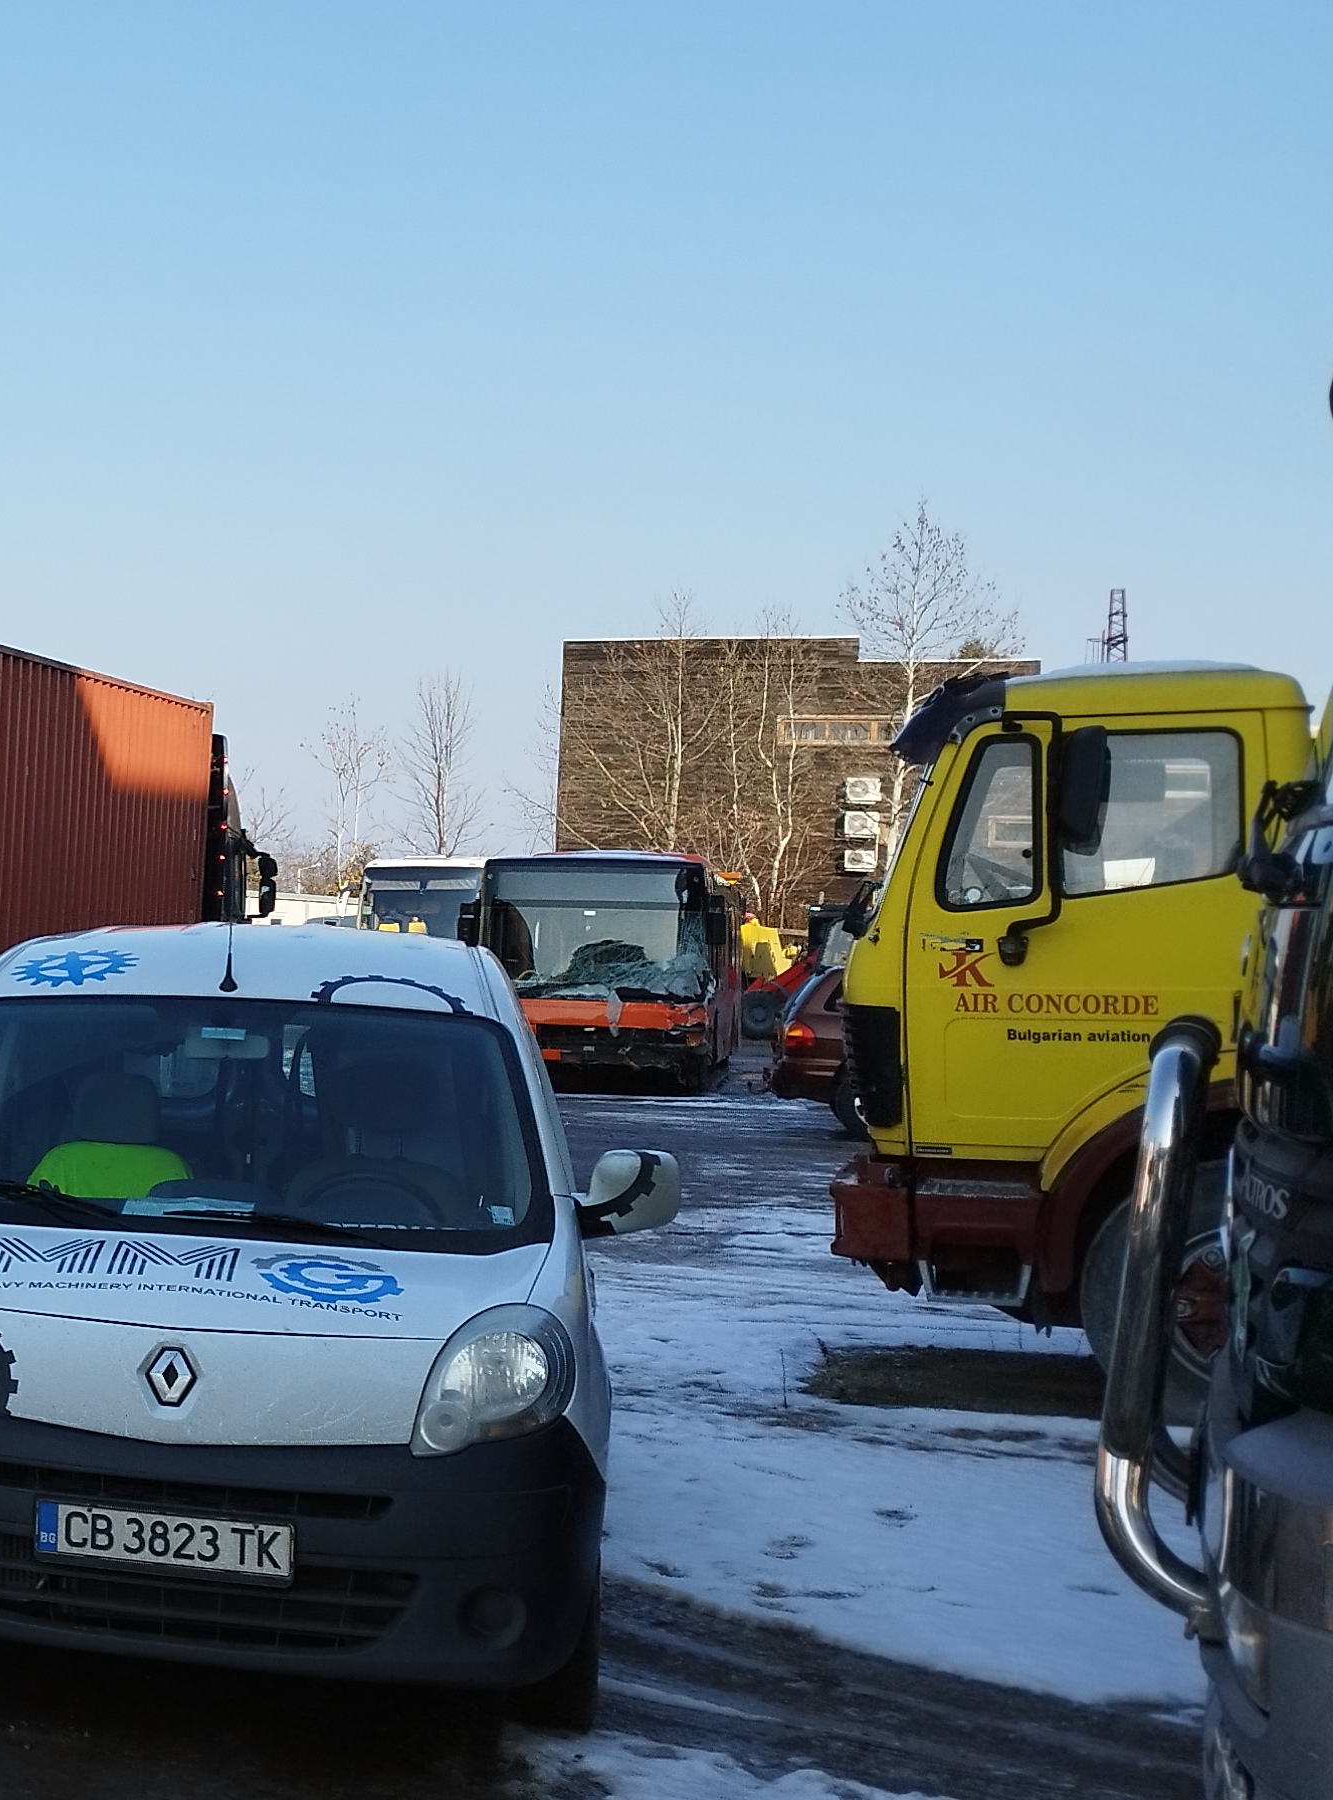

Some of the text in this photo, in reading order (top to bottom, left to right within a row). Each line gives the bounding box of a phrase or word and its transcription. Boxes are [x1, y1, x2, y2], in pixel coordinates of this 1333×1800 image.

[954, 993, 1159, 1015] AIR CONCORDE
[1007, 1028, 1151, 1044] Bulgarian aviation
[28, 1281, 133, 1291] MACHINERY
[137, 1283, 283, 1304] INTERNATIONAL
[288, 1298, 404, 1322] TRANSPORT
[39, 1531, 57, 1544] BG
[64, 1510, 282, 1570] CB 3823 TK
